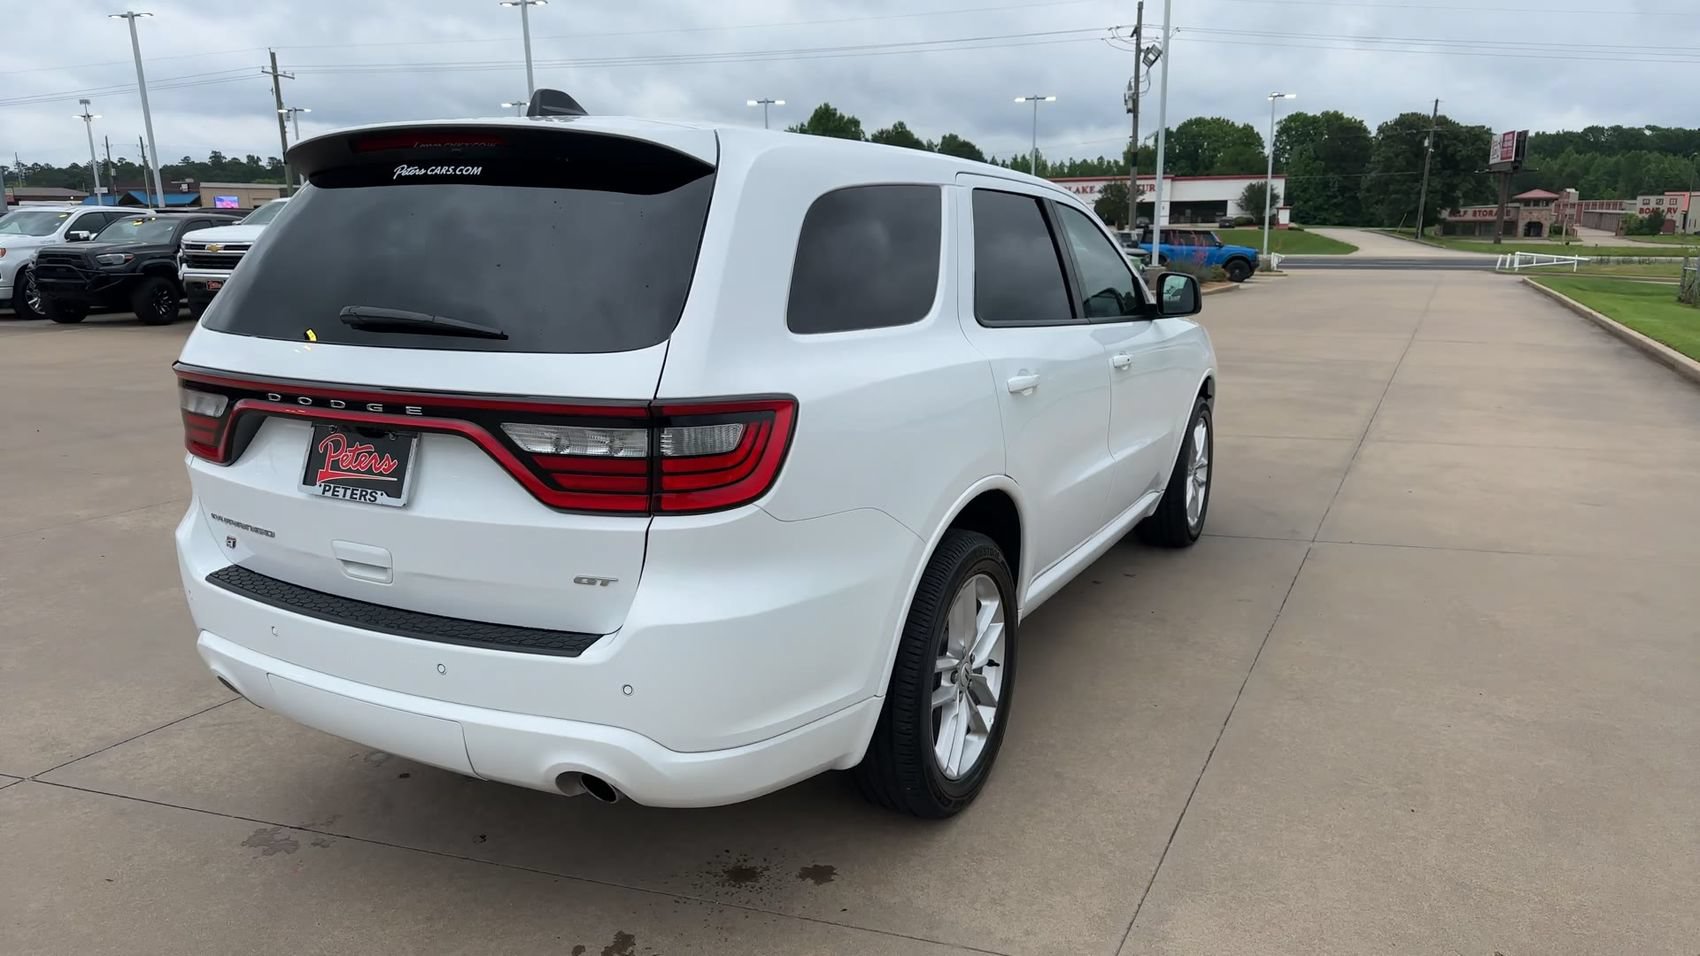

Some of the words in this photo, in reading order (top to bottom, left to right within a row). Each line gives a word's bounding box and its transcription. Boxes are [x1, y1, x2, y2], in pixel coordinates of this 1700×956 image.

[393, 164, 426, 179] Peters
[427, 166, 483, 175] CARS.COM
[1472, 209, 1511, 217] STORAE
[267, 393, 423, 415] DODGE
[318, 433, 398, 474] Peters
[321, 484, 379, 503] PETERS
[573, 576, 619, 587] GT
